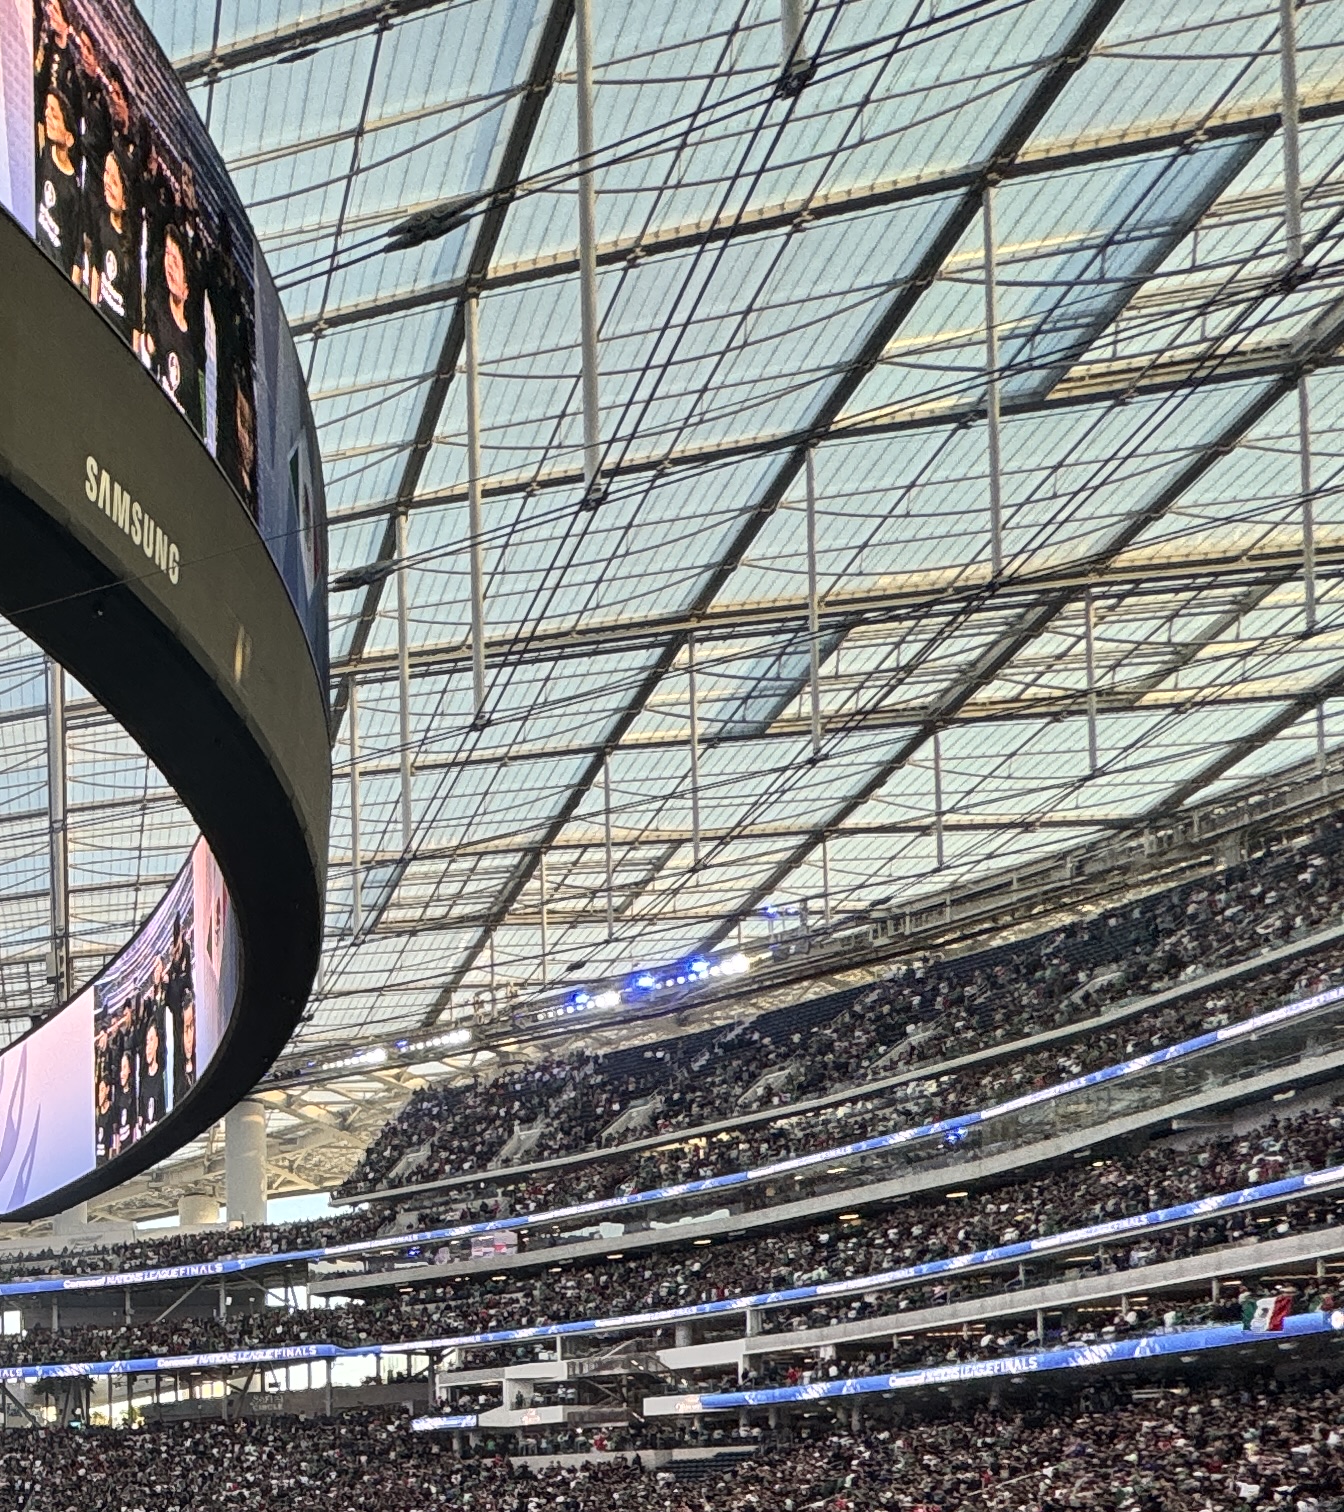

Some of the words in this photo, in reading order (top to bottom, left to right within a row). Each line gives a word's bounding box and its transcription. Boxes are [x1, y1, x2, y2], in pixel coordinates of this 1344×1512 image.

[85, 456, 179, 584] SAMSUNG
[178, 1263, 223, 1278] FINALS
[273, 1346, 317, 1360] FINALS
[993, 1356, 1037, 1373] FINALS
